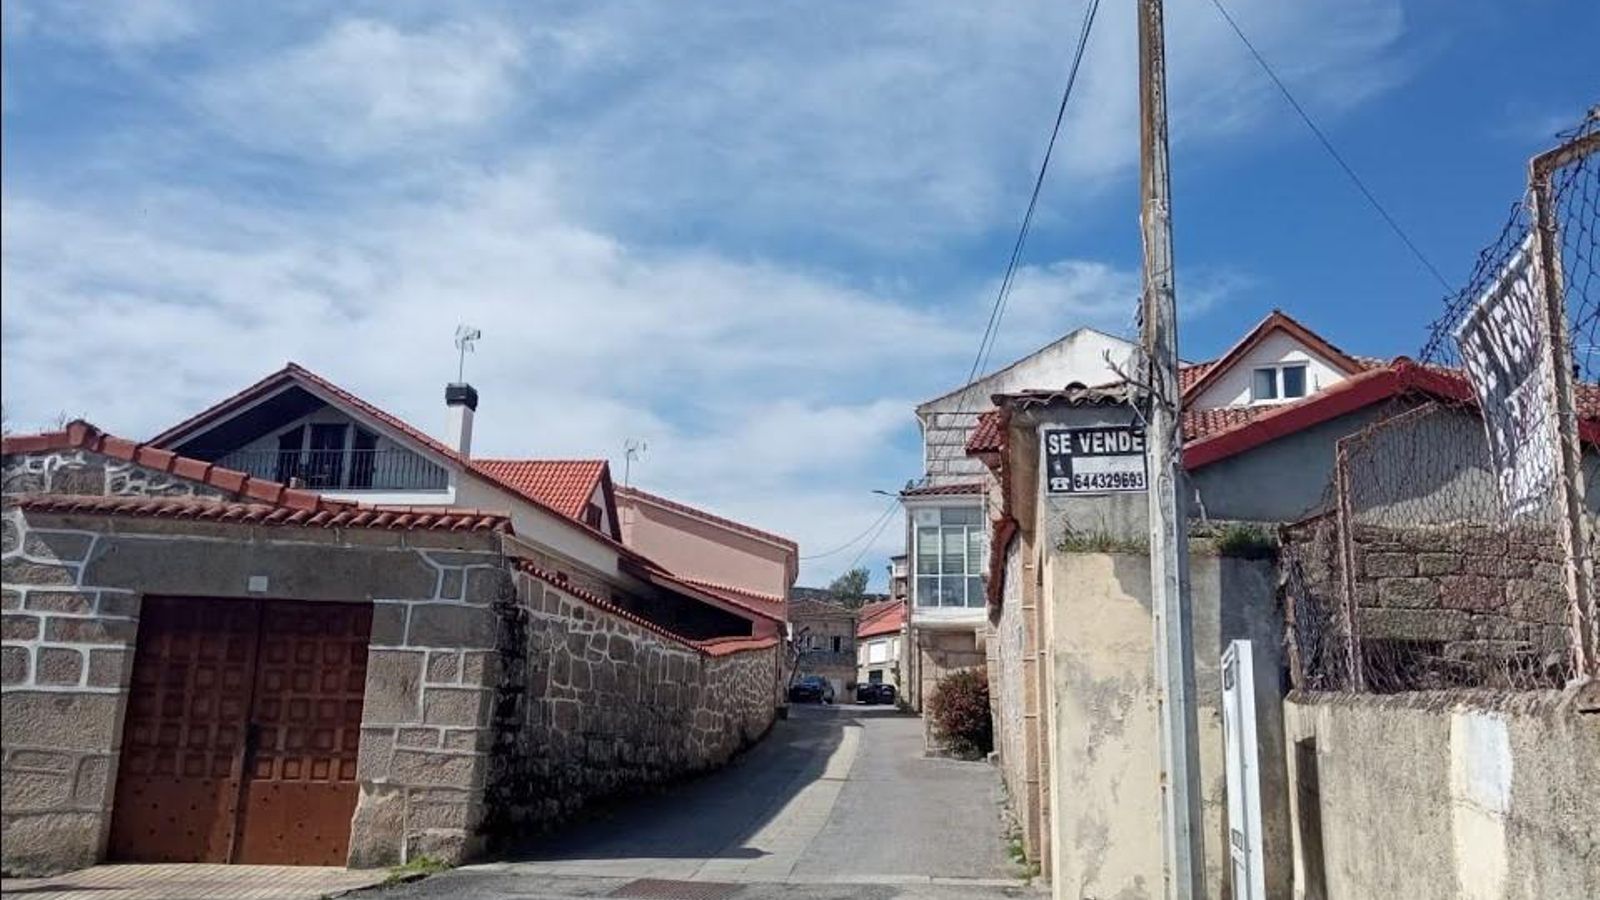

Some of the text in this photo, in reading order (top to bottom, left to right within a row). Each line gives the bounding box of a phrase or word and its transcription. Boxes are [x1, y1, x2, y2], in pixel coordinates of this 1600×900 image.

[1048, 431, 1144, 455] SE VENDE
[1074, 471, 1143, 489] 644329693
